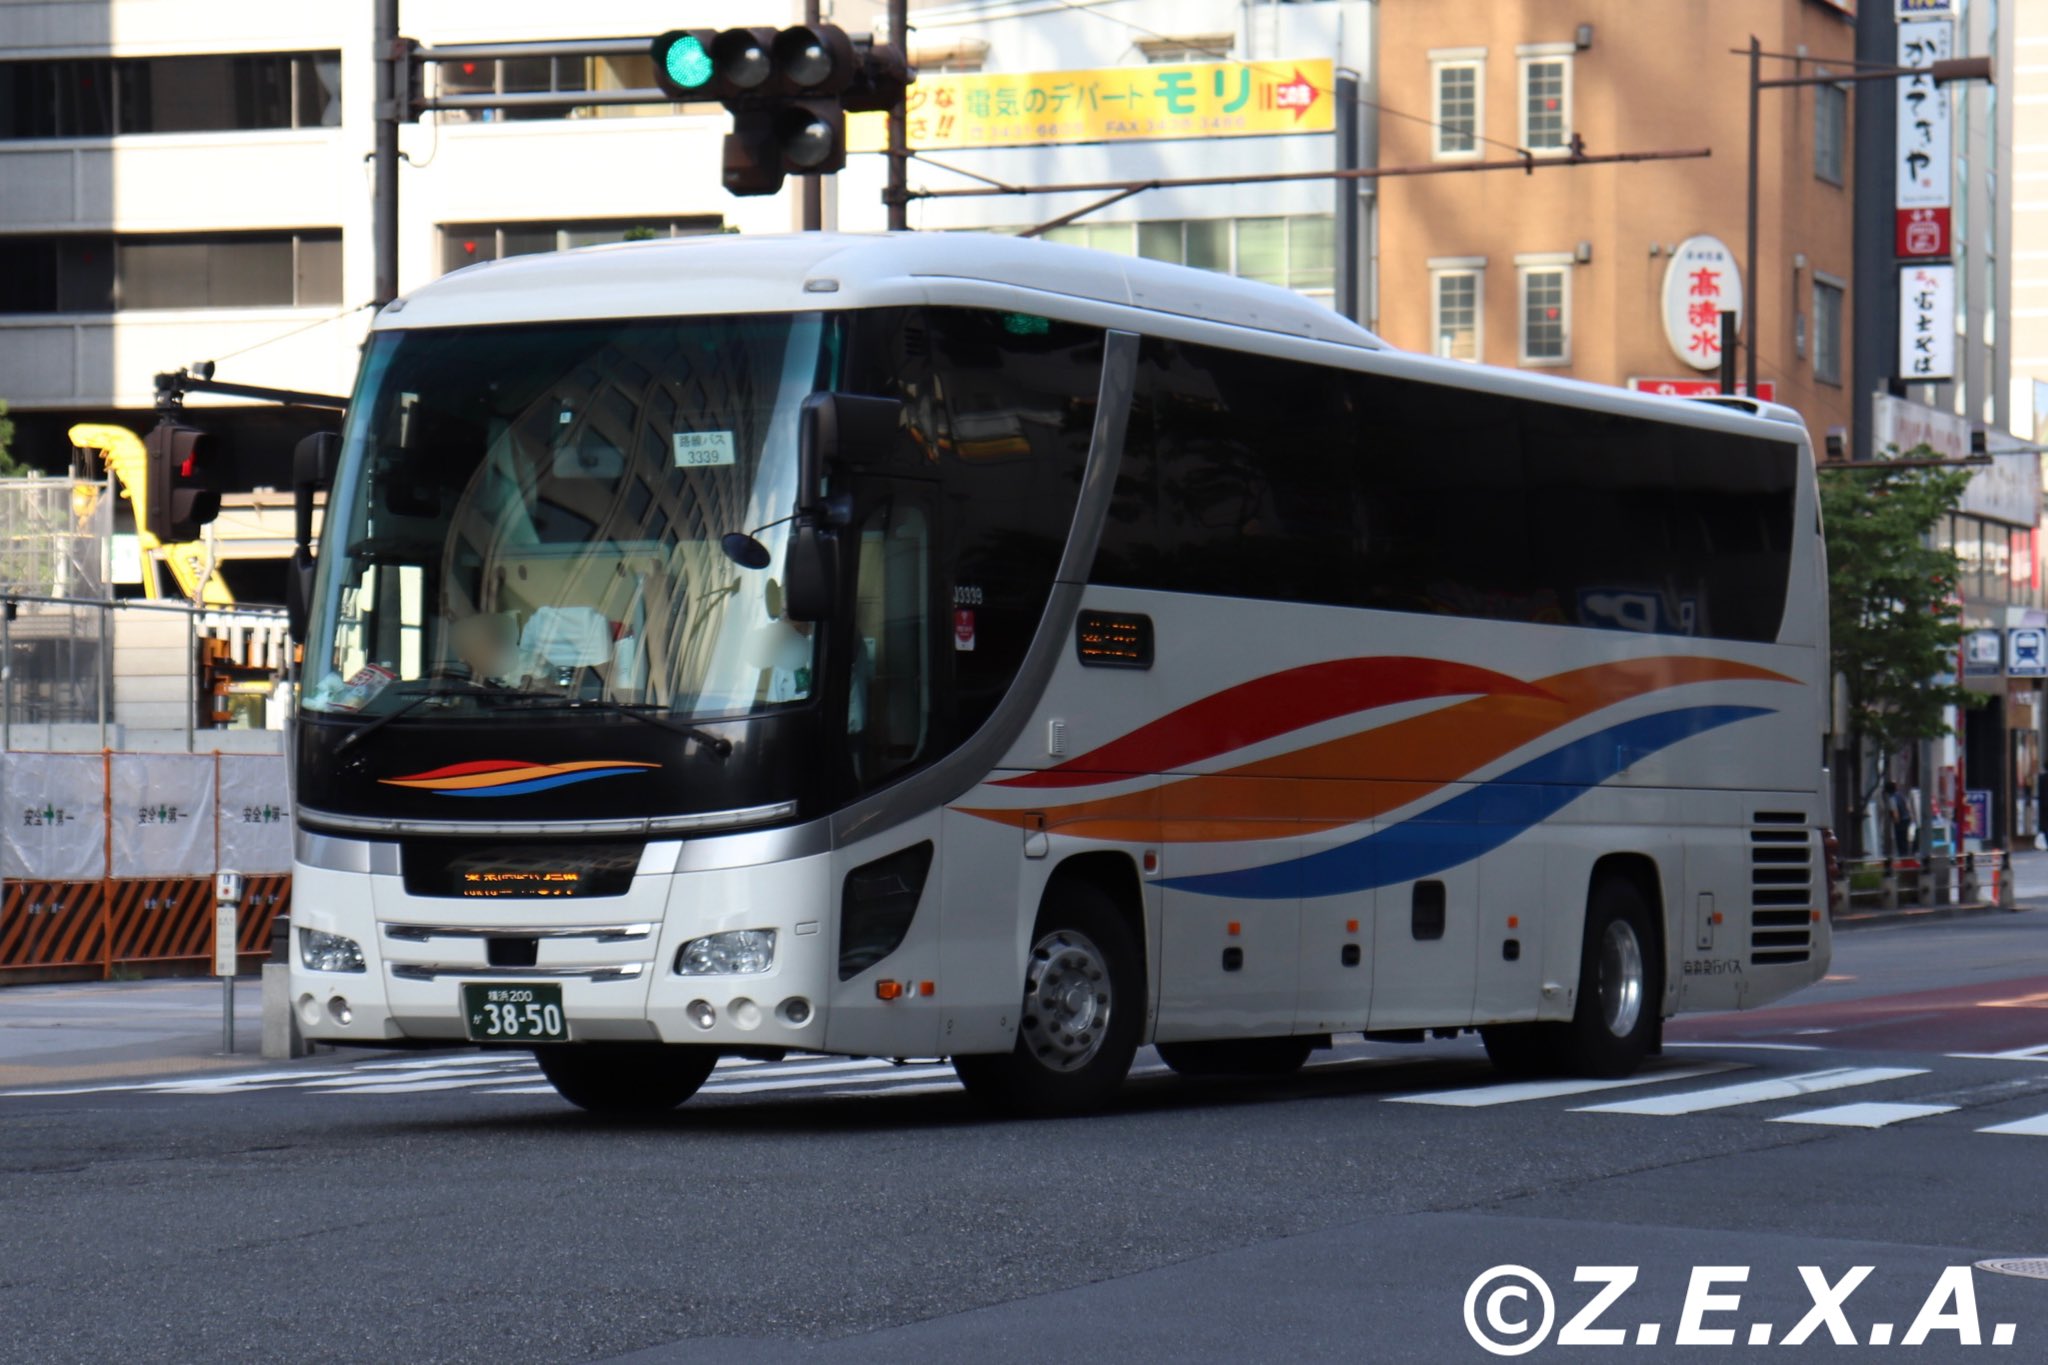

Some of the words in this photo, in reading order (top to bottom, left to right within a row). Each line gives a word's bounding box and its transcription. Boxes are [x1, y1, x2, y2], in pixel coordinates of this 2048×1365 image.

[1154, 67, 1251, 114] モリ
[688, 450, 719, 464] 3339
[483, 1003, 562, 1036] 38-50
